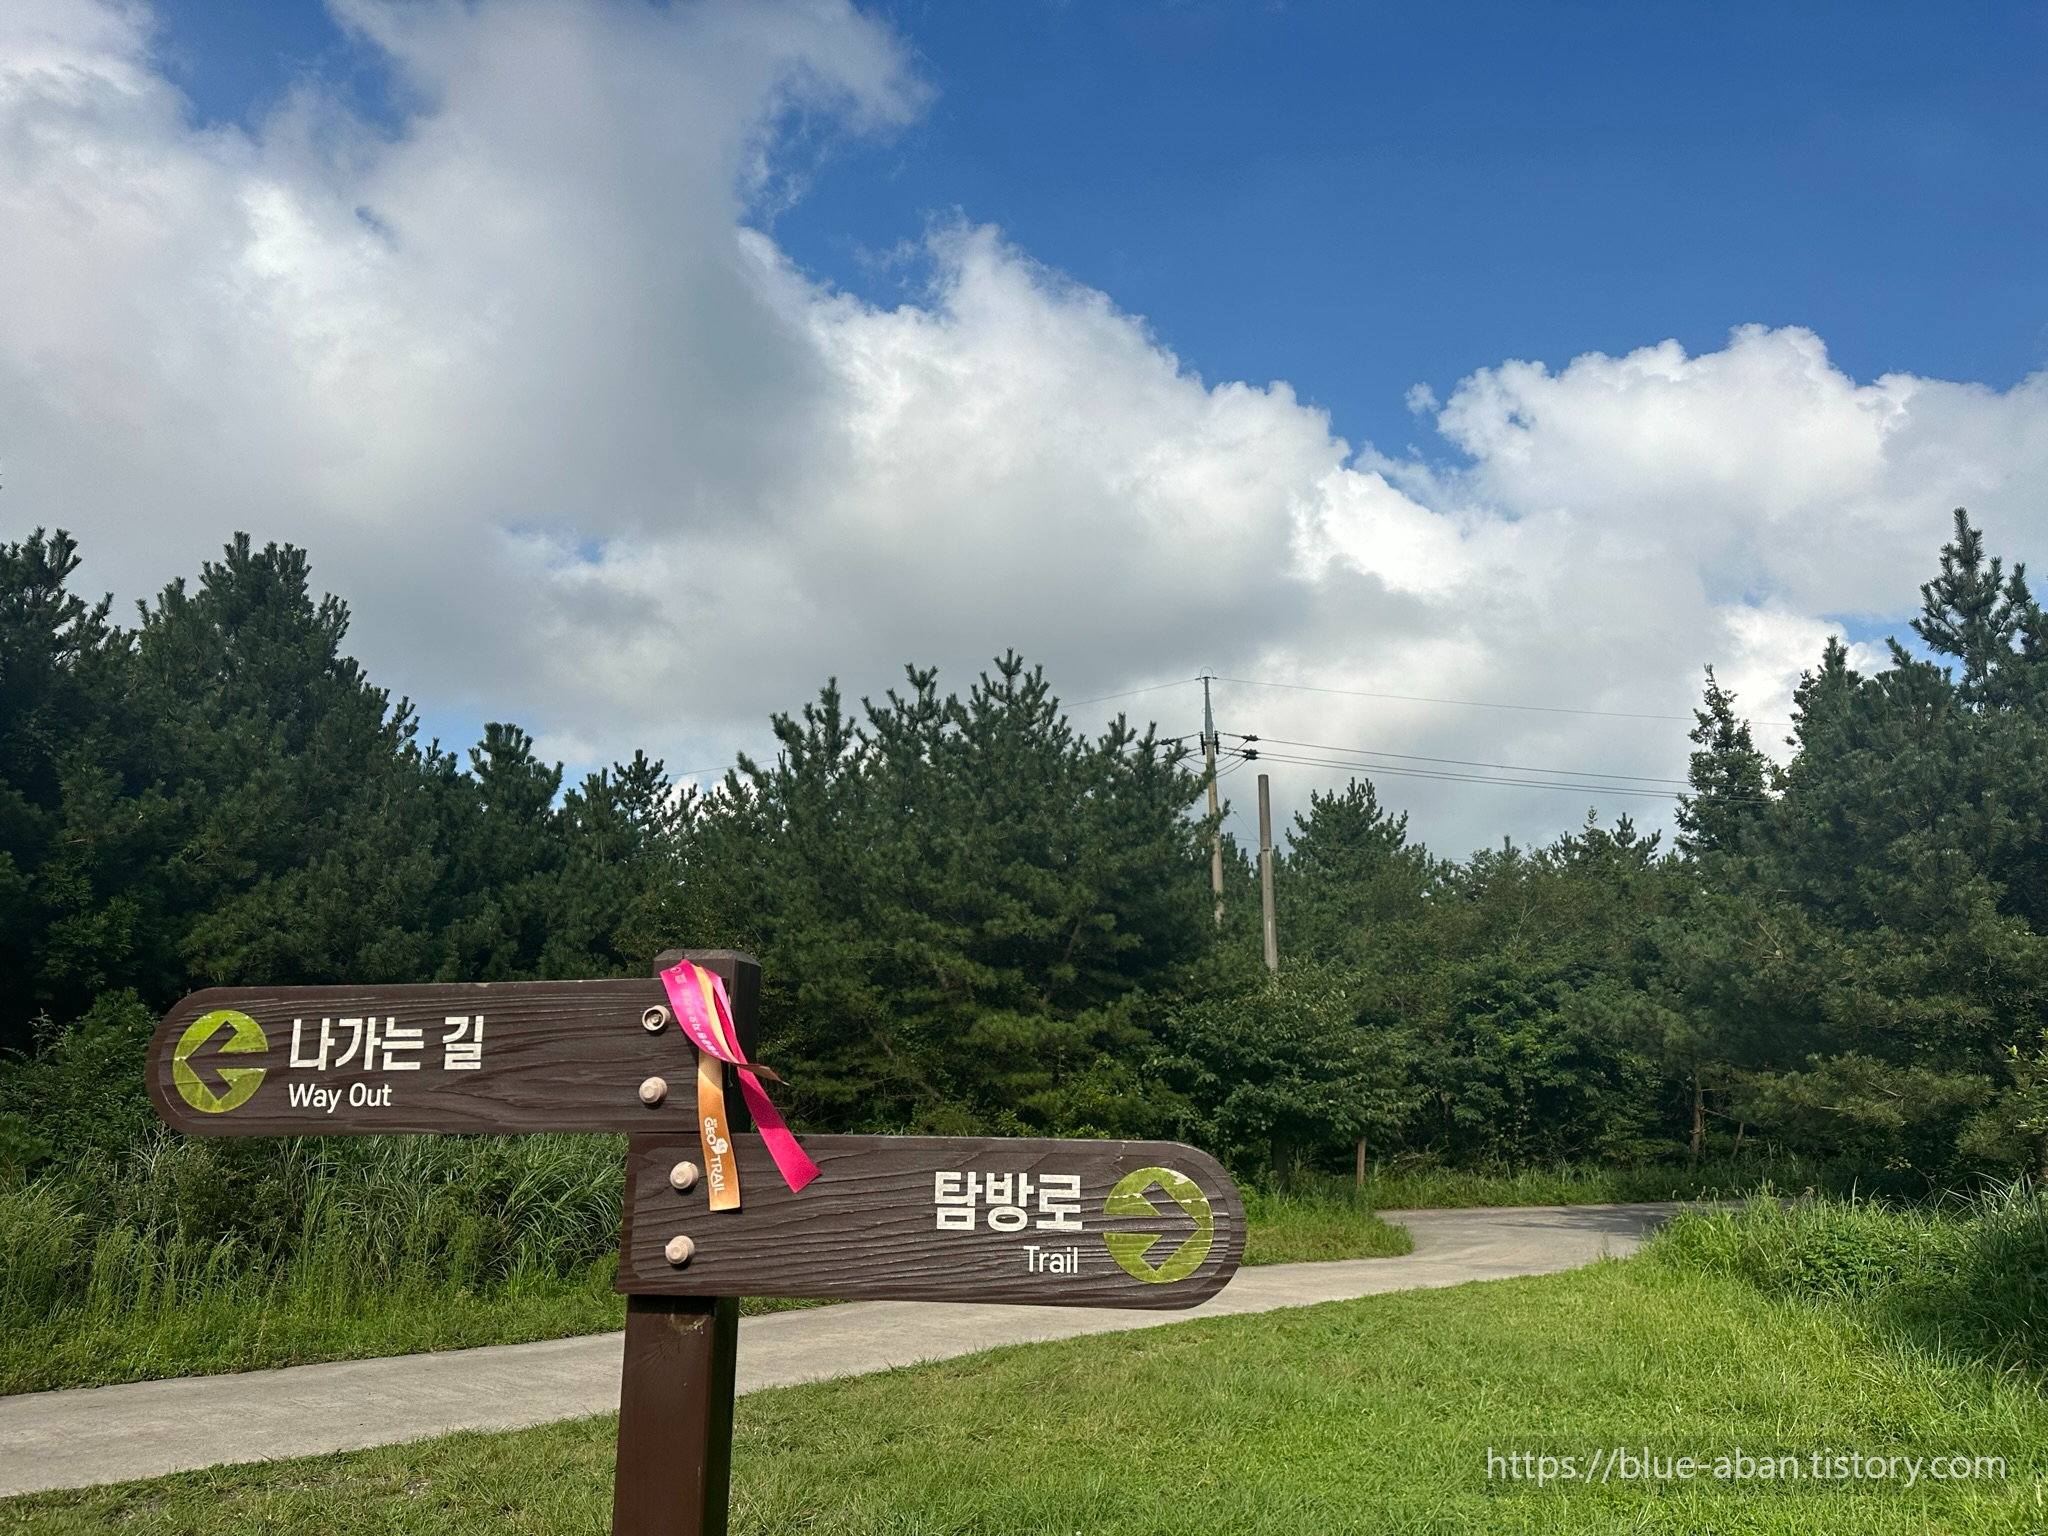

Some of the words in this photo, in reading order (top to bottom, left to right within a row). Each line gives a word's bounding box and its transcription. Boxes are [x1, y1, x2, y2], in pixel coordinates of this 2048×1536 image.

[289, 1016, 425, 1071] 나가는
[442, 1015, 484, 1070] 길
[288, 1083, 342, 1113] Way
[349, 1083, 393, 1107] Out
[704, 1117, 717, 1146] GEO
[710, 1155, 726, 1196] TRAIL
[934, 1171, 1083, 1232] 탐방로
[1023, 1246, 1078, 1274] Trail
